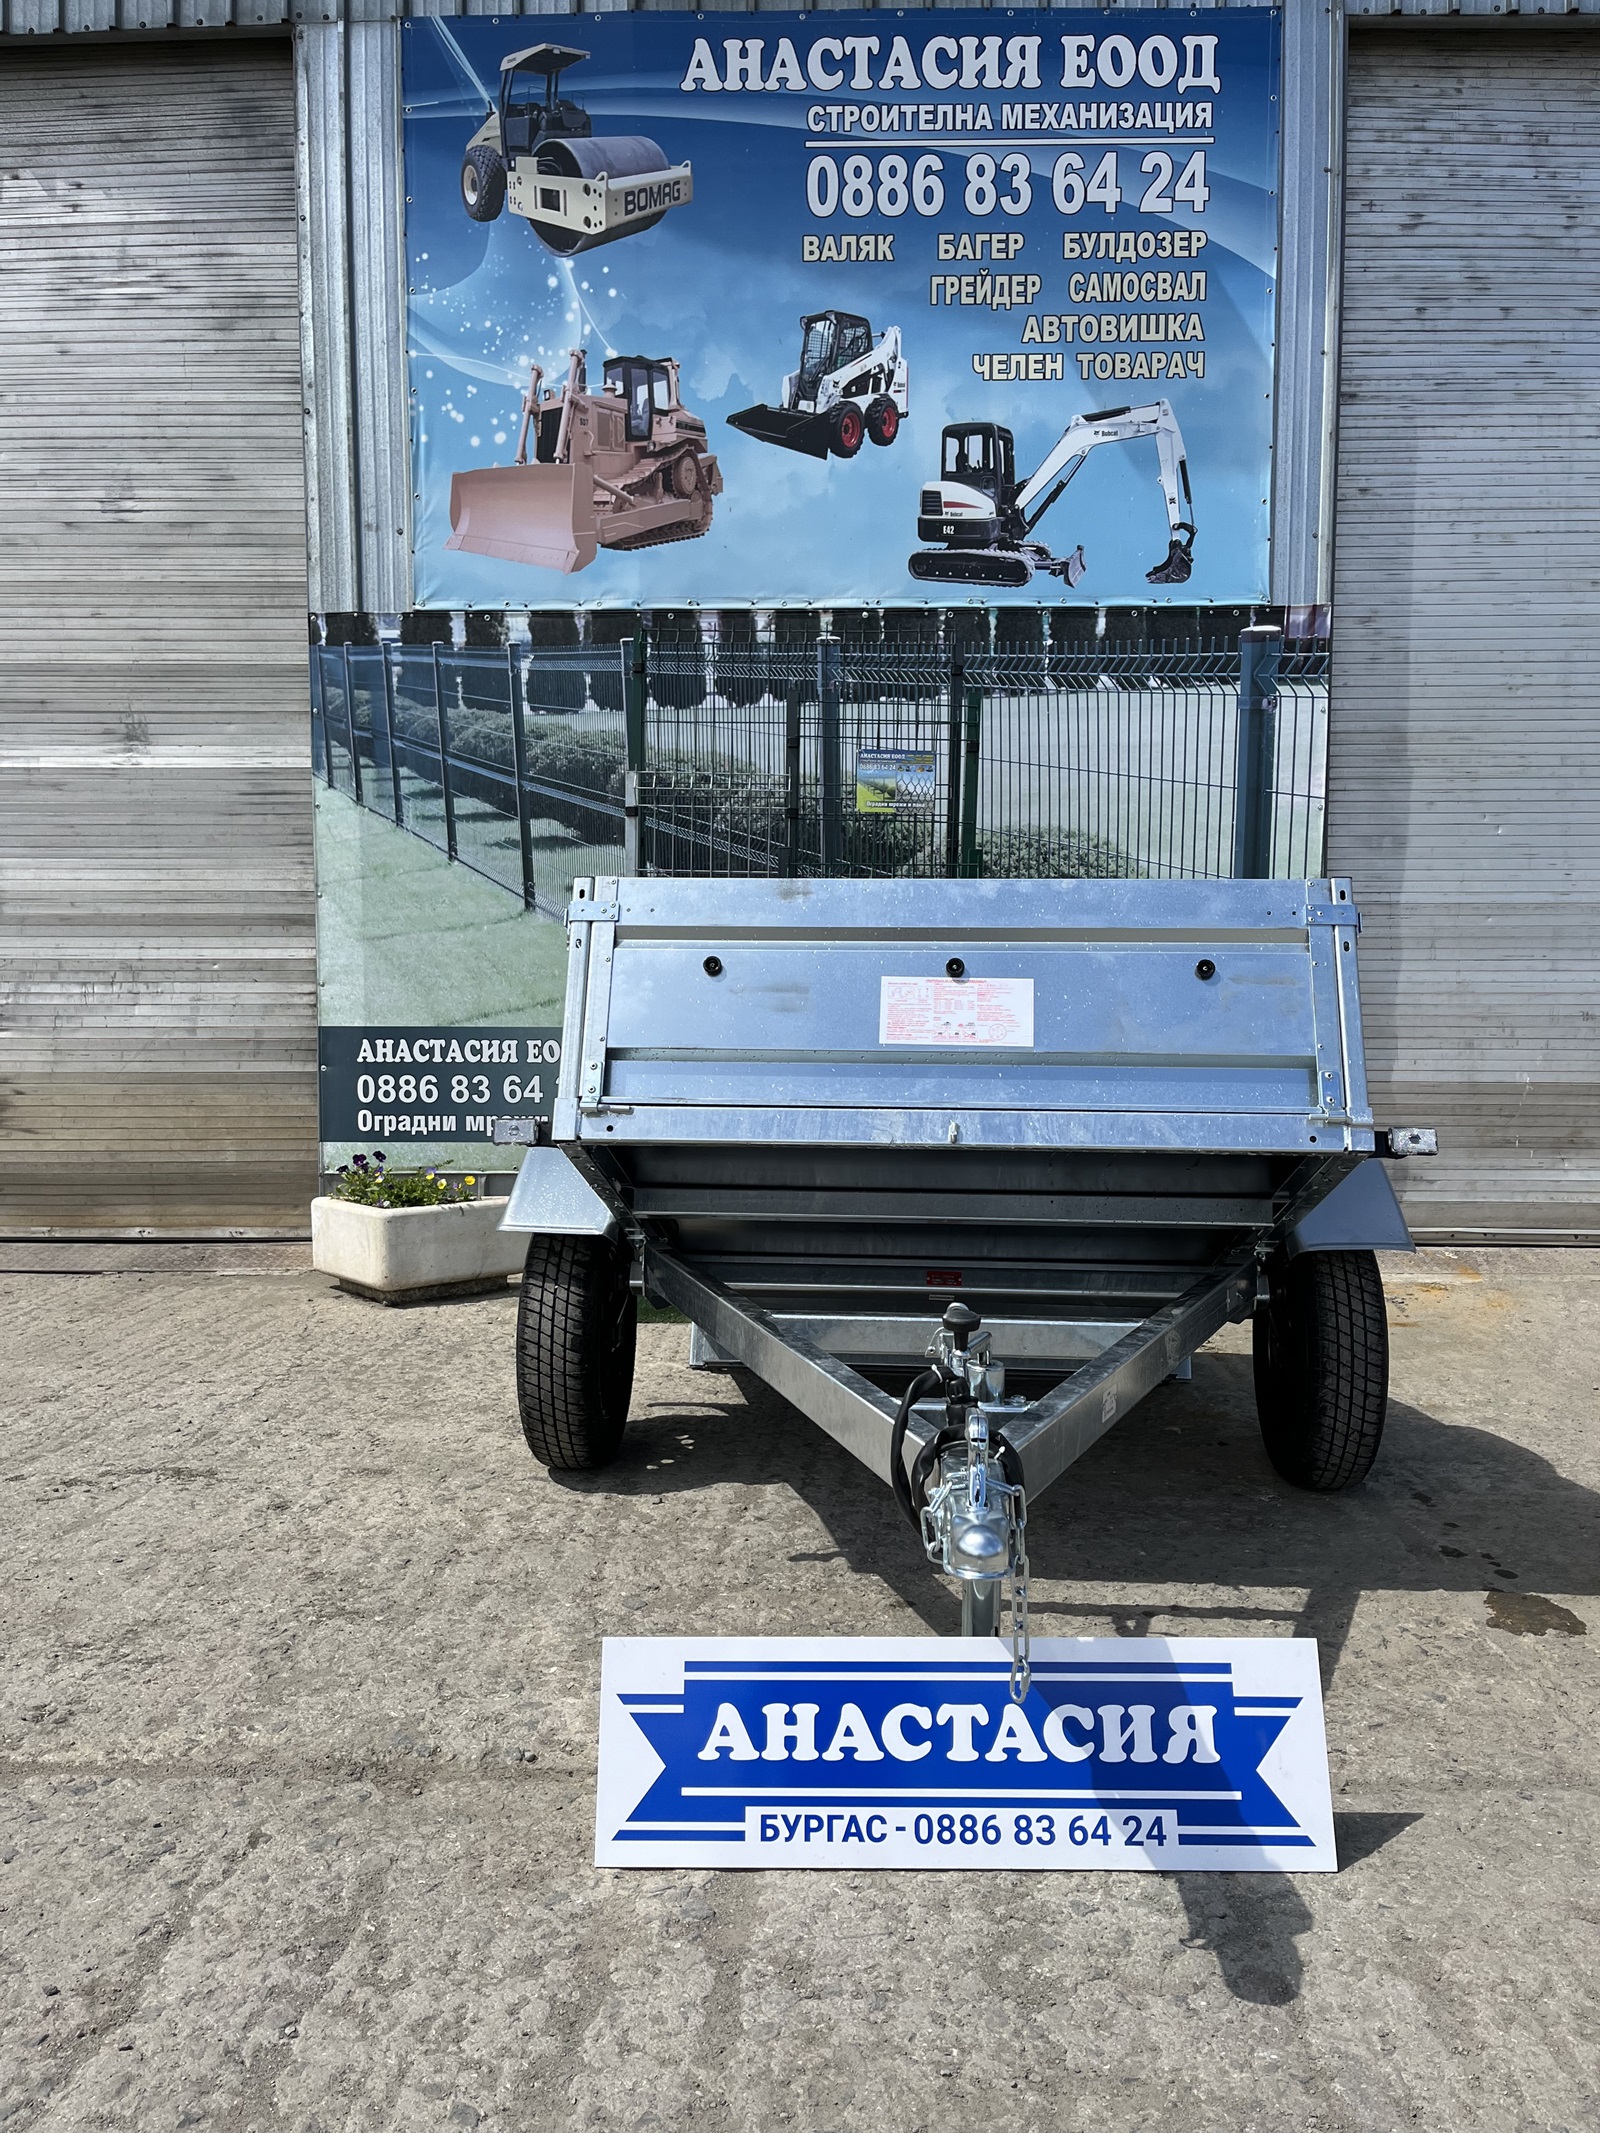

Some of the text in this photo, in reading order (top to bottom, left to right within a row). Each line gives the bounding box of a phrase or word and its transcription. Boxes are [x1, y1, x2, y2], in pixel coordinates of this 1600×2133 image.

[681, 34, 1222, 94] АНАСТАСИЯ ЕООД
[806, 102, 1214, 134] СТРОИТЕЛНА МЕХАНИЗАЦИЯ
[624, 180, 681, 216] BOMAG
[805, 151, 1210, 218] 0886 83 64 24
[802, 231, 1208, 265] ВАЛЯК БАГЕР БУЛДОЗЕР
[930, 269, 1207, 311] ГРЕЙДЕР САМОСВАЛ
[1021, 313, 1205, 344] АВТОВИШКА
[972, 352, 1206, 381] ЧЕЛЕН ТОВАРАЧ
[943, 525, 955, 535] E42
[356, 1039, 561, 1063] АНАСТАСИЯ ЕО
[356, 1074, 544, 1104] 0886 83 64
[357, 1109, 457, 1136] Оградни
[697, 1702, 1221, 1764] АНАСТАСИЯ
[759, 1813, 888, 1844] БУРГАС
[914, 1813, 1001, 1846] 0886
[1013, 1814, 1056, 1846] 83
[1068, 1815, 1112, 1846] 64
[1123, 1816, 1167, 1847] 24
